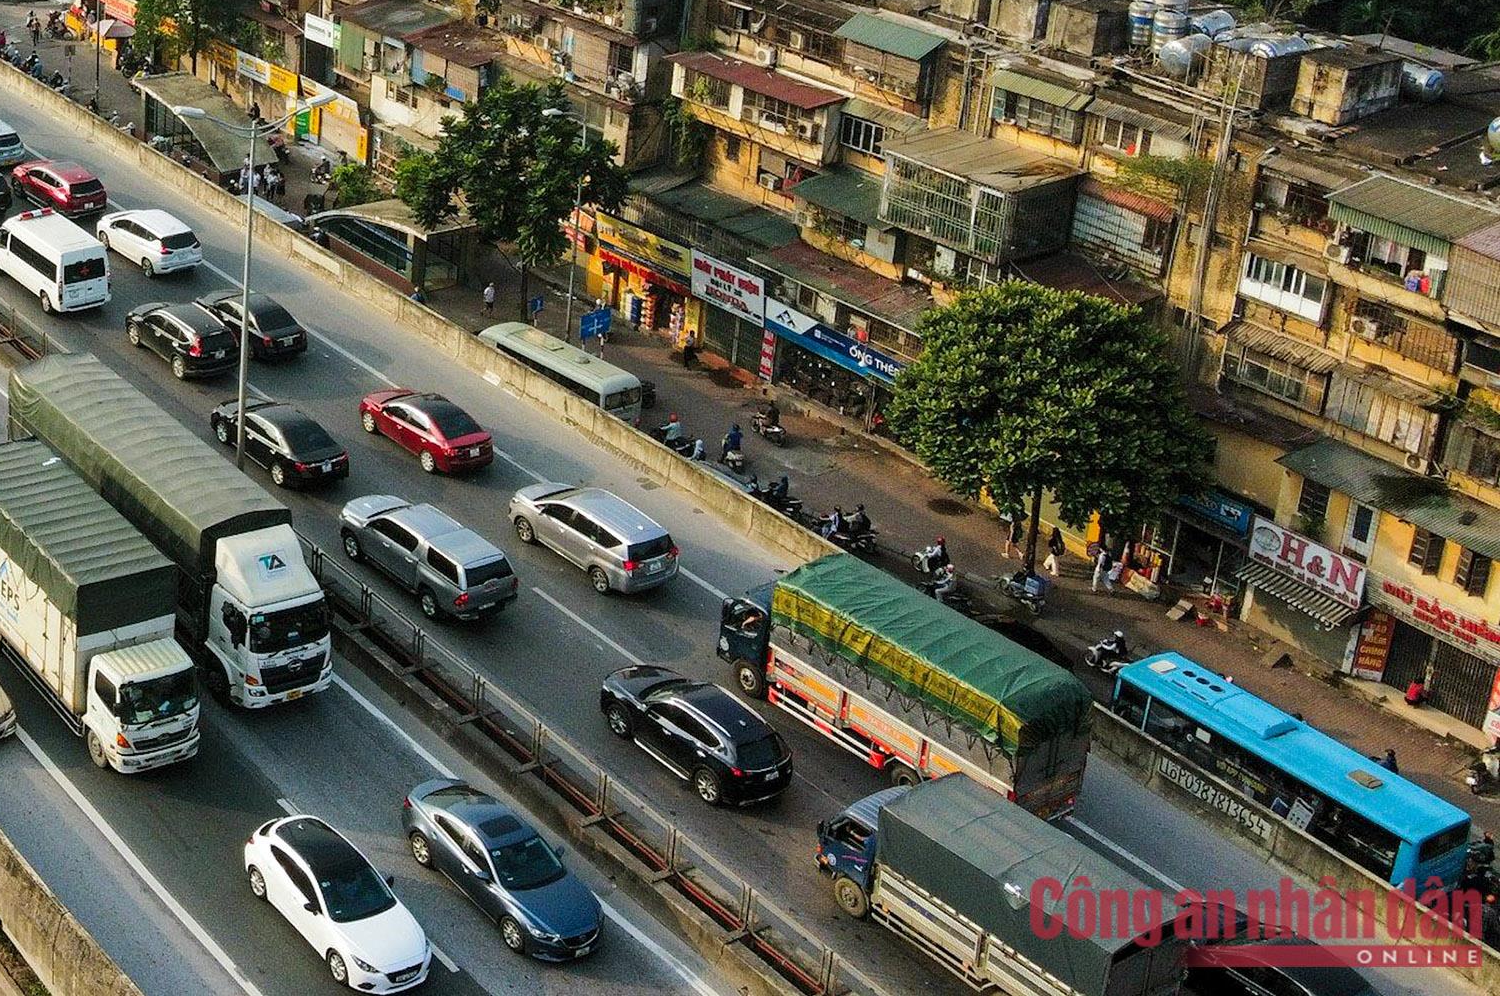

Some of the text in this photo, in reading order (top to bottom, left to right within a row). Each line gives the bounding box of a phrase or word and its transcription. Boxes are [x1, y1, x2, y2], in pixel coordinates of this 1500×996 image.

[258, 554, 287, 571] TA
[1278, 530, 1362, 596] H&N
[1, 580, 20, 611] EPS
